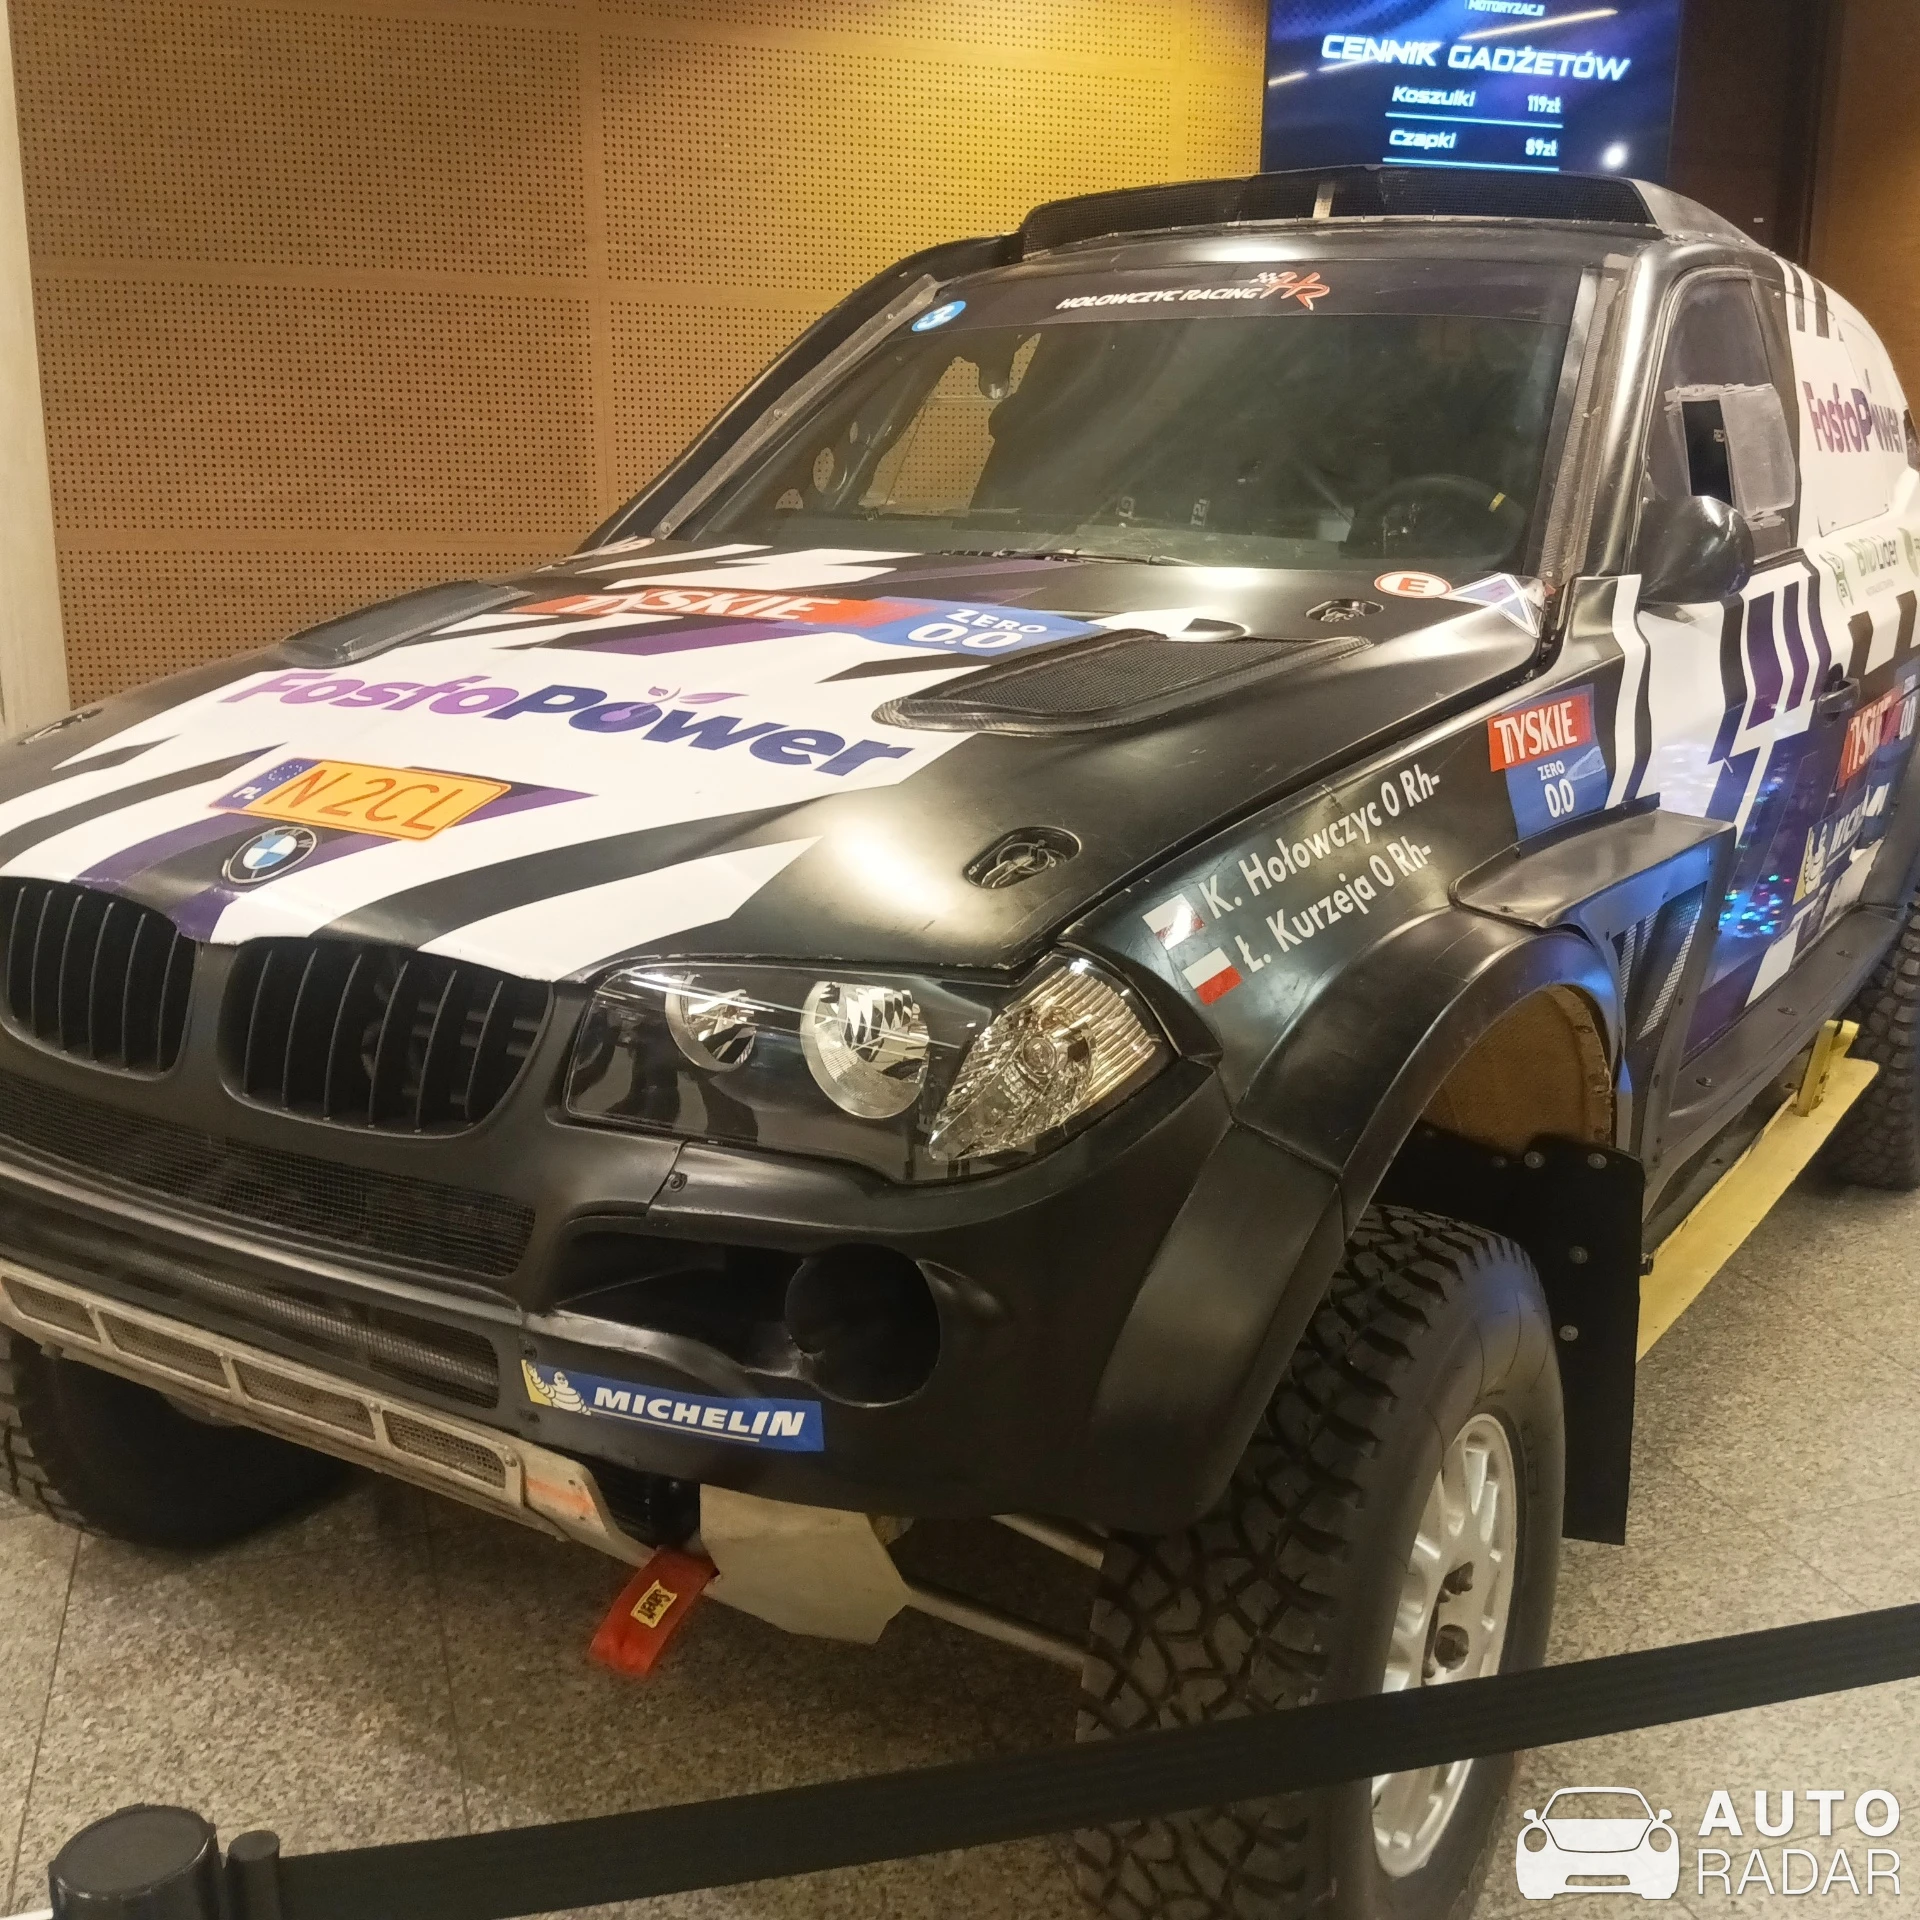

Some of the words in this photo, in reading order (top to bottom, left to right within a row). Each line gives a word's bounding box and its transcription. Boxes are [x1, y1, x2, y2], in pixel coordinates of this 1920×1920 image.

[1321, 34, 1440, 66] CENNIK
[1448, 45, 1631, 81] GADŻETÓW
[1391, 85, 1476, 107] Koszulki
[1528, 95, 1561, 114] 119zł
[1388, 130, 1457, 150] Czapki
[1525, 139, 1558, 157] 89zł
[1178, 287, 1263, 302] RACING
[1398, 577, 1429, 593] E
[555, 588, 840, 620] TYSKIE
[898, 622, 1023, 649] 0.0
[945, 608, 1047, 633] ZERO
[220, 672, 914, 775] FosfoPower
[1494, 701, 1577, 764] TYSKIE
[1537, 760, 1566, 781] ZERO
[1544, 778, 1575, 818] 0.0
[1198, 874, 1242, 919] K.
[1238, 801, 1382, 896] Hołowczyc
[1400, 764, 1440, 807] Rh-
[1234, 935, 1271, 973] Ł.
[1266, 873, 1377, 952] Kurzeja
[1386, 836, 1431, 876] Rh-
[594, 1386, 805, 1436] MICHELIN
